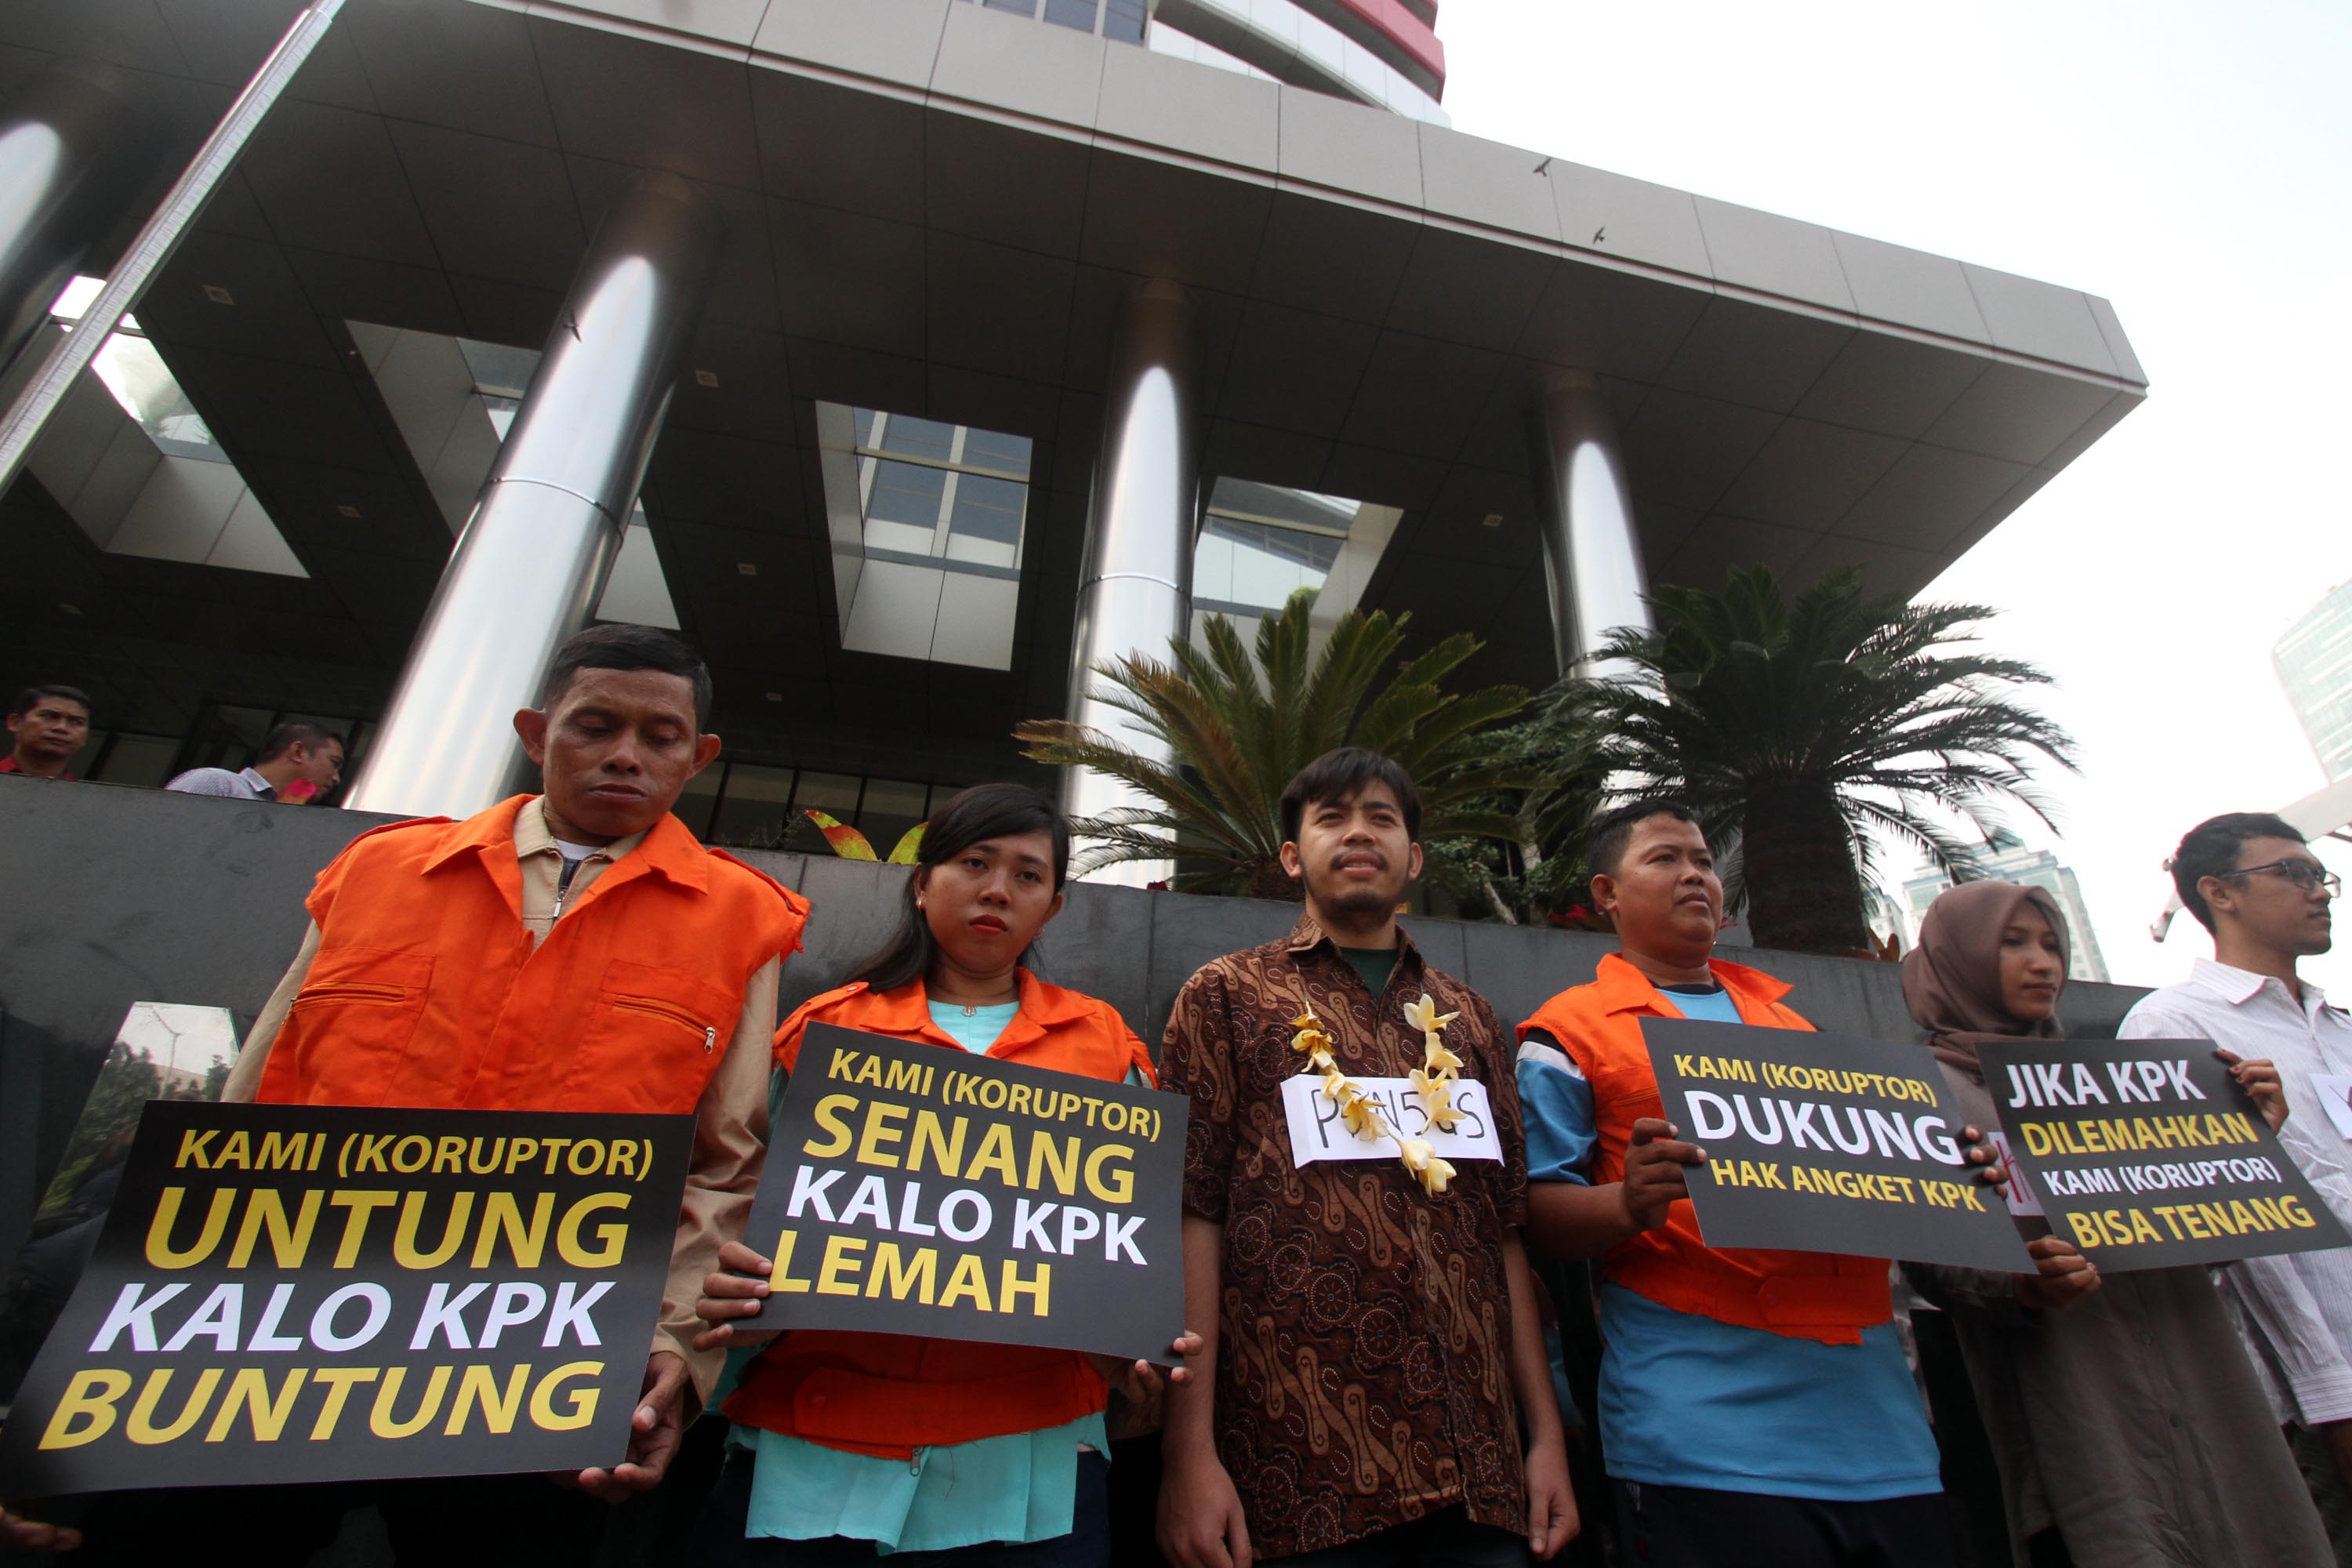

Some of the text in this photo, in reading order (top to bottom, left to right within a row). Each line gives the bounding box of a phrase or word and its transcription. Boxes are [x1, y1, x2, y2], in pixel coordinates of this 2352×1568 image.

[829, 1047, 1161, 1142] KAMI (KORUPTOR)
[1674, 1054, 1938, 1108] KAMI (KORUPTOR)
[2005, 1060, 2207, 1108] JIKA KPK
[176, 1129, 653, 1181] KAMI (KORUPTOR)
[803, 1094, 1134, 1203] SENANG
[1684, 1091, 1965, 1165] DUKUNG
[2020, 1112, 2259, 1156] DILEMAHKAN
[1709, 1160, 1987, 1213] HAK ANGKET KPK
[2042, 1169, 2119, 1196] KAMI
[2119, 1157, 2282, 1195] (KORUPTOR)
[144, 1186, 632, 1270] UNTUNG
[786, 1165, 1147, 1265] KALO KPK
[2067, 1196, 2317, 1249] BISA TENANG
[769, 1230, 1051, 1316] LEMAH
[89, 1281, 616, 1352] KALO KPK
[38, 1360, 605, 1451] BUNTUNG
